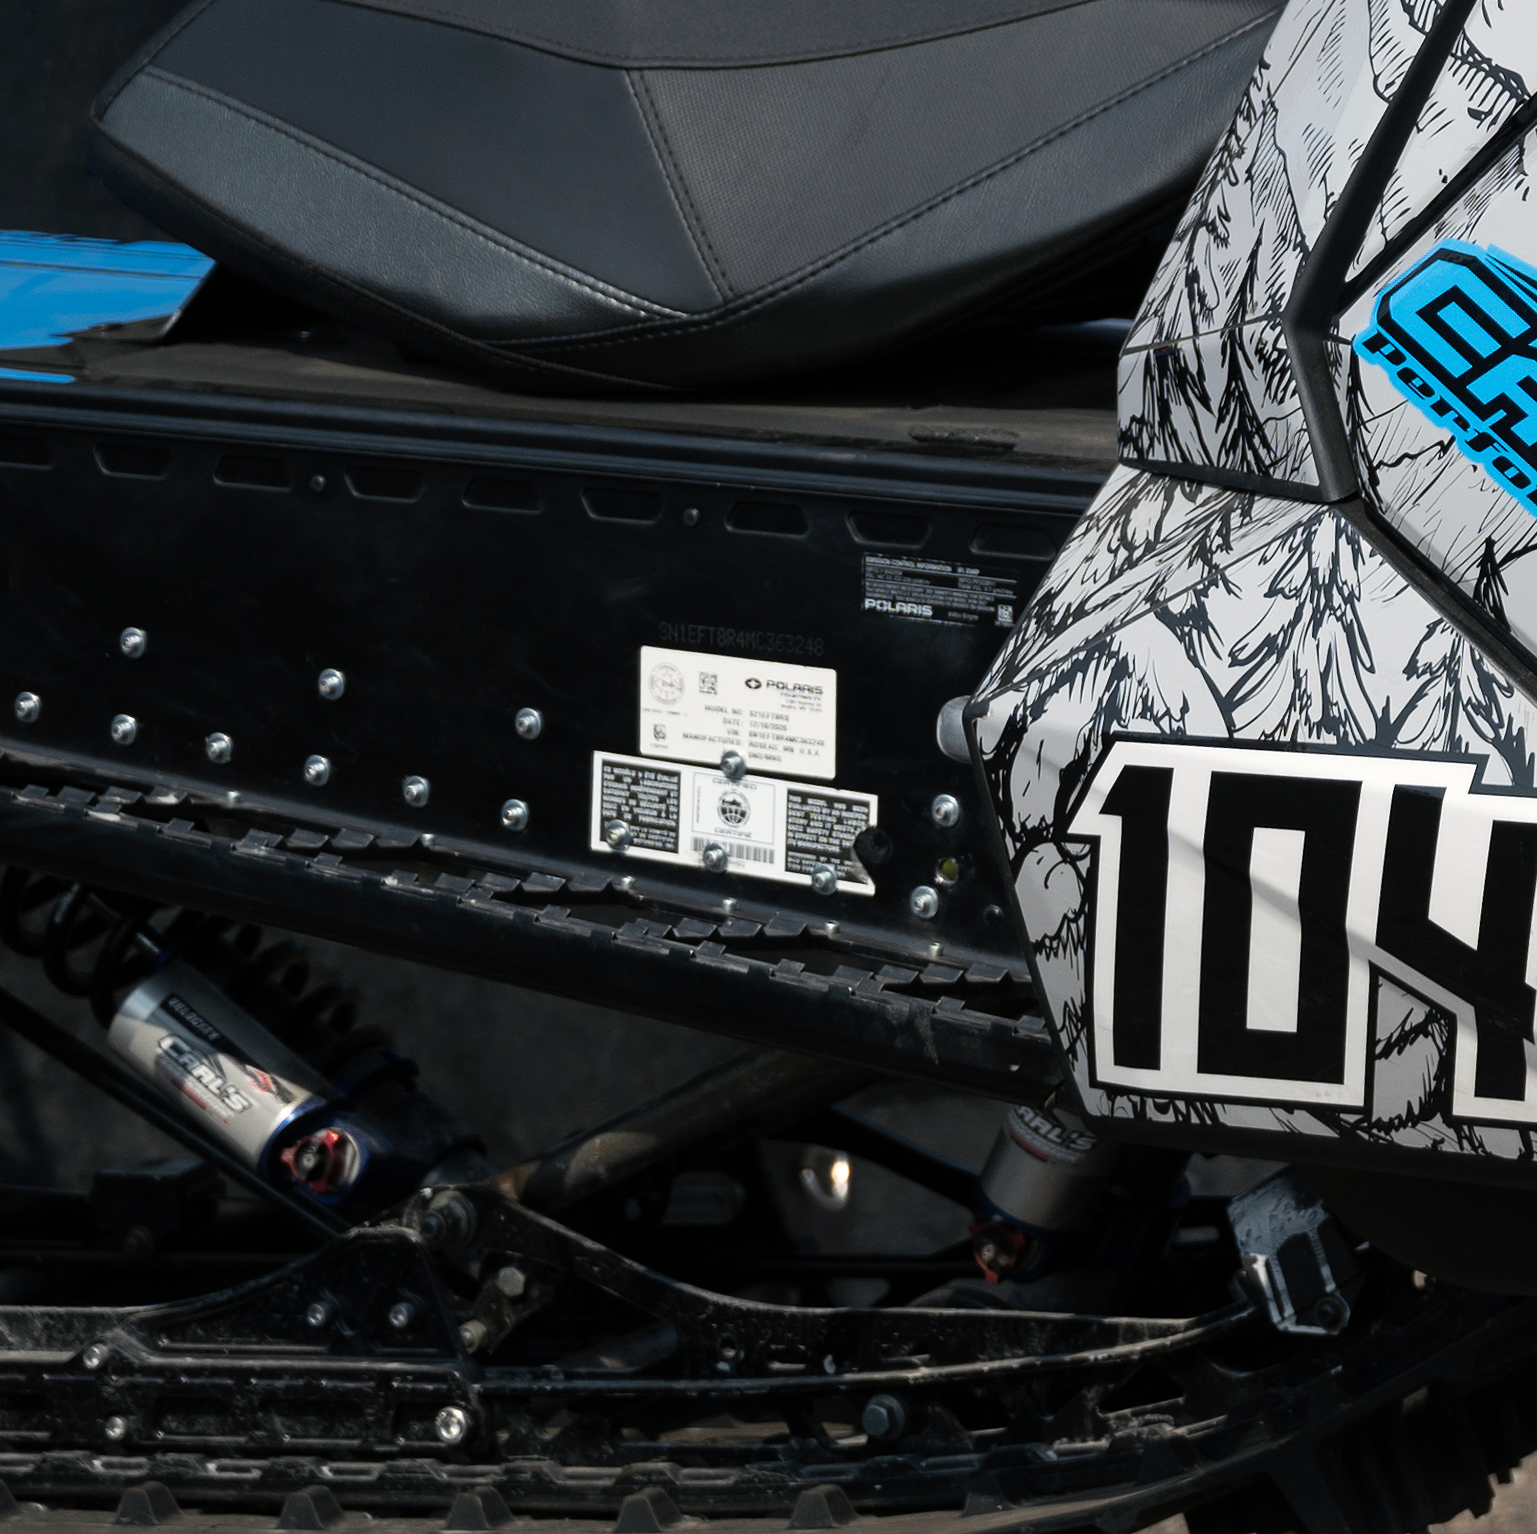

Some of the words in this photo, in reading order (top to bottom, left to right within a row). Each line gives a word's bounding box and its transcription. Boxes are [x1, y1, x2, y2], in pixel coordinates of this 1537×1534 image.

[864, 598, 933, 617] POLARIS
[766, 679, 823, 695] POLARIS
[158, 1033, 252, 1114] CARL'S
[1017, 1105, 1099, 1152] ARL'S
